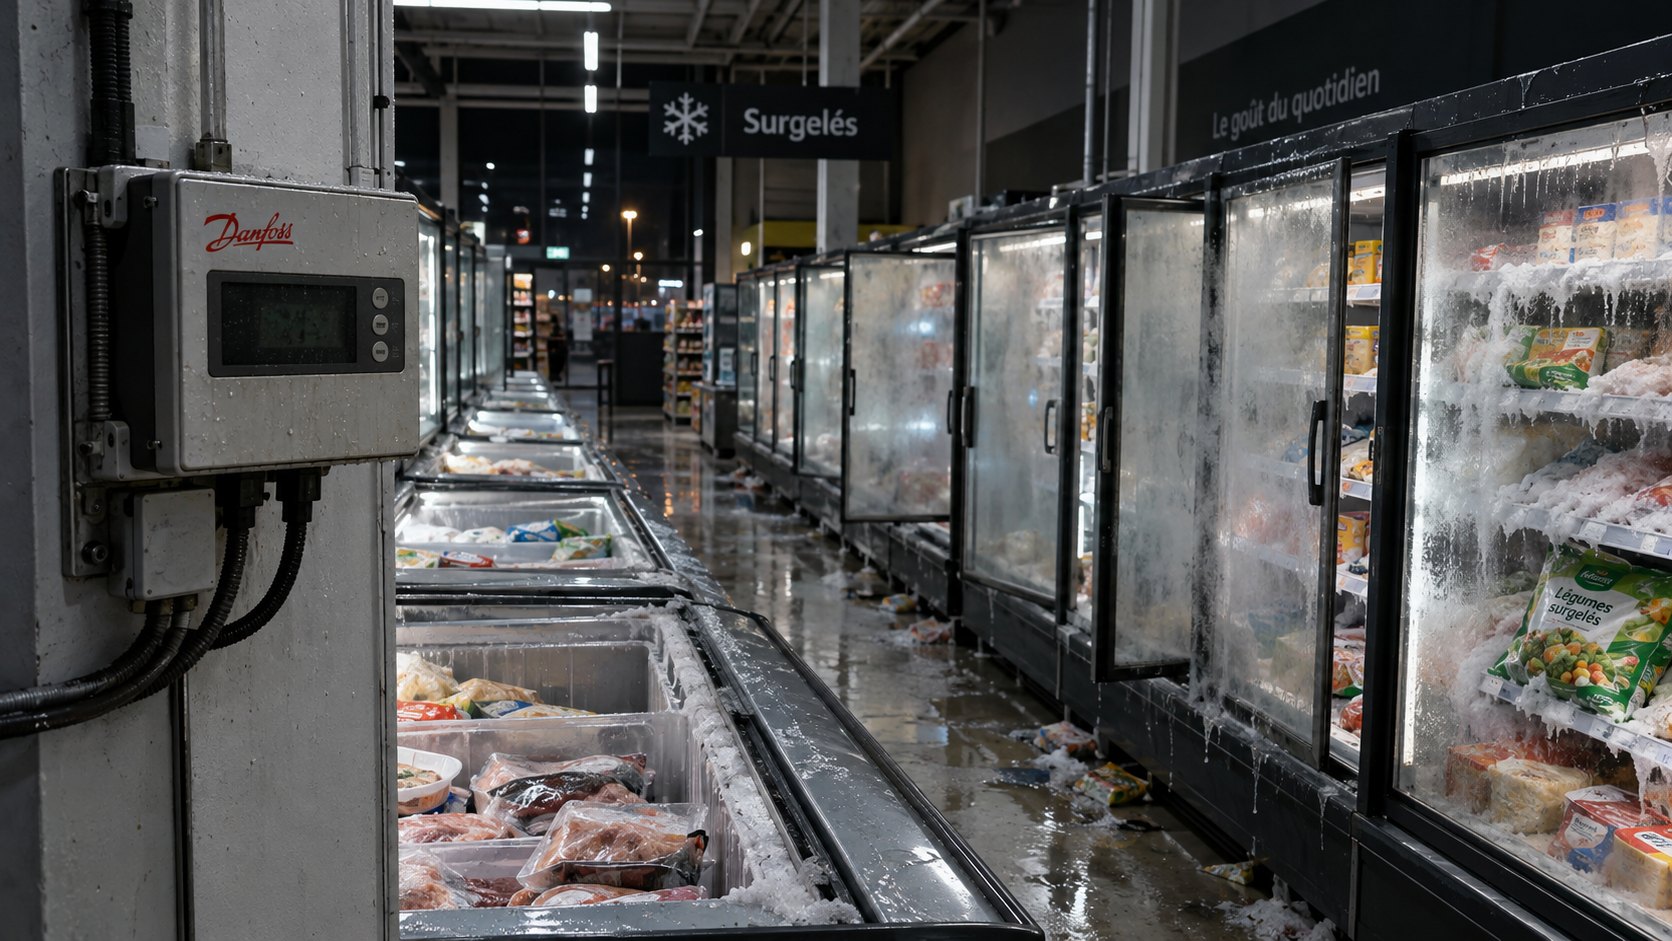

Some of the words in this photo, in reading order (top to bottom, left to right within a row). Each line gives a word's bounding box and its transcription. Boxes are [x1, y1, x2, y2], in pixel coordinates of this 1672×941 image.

[1212, 111, 1229, 139] Le
[1230, 98, 1265, 141] goût
[1267, 91, 1288, 123] du
[1291, 66, 1380, 123] quotidien
[743, 107, 859, 142] Surgelés
[203, 212, 294, 252] Danfoss
[1548, 603, 1602, 626] surgelés
[1554, 586, 1614, 614] Légumes
